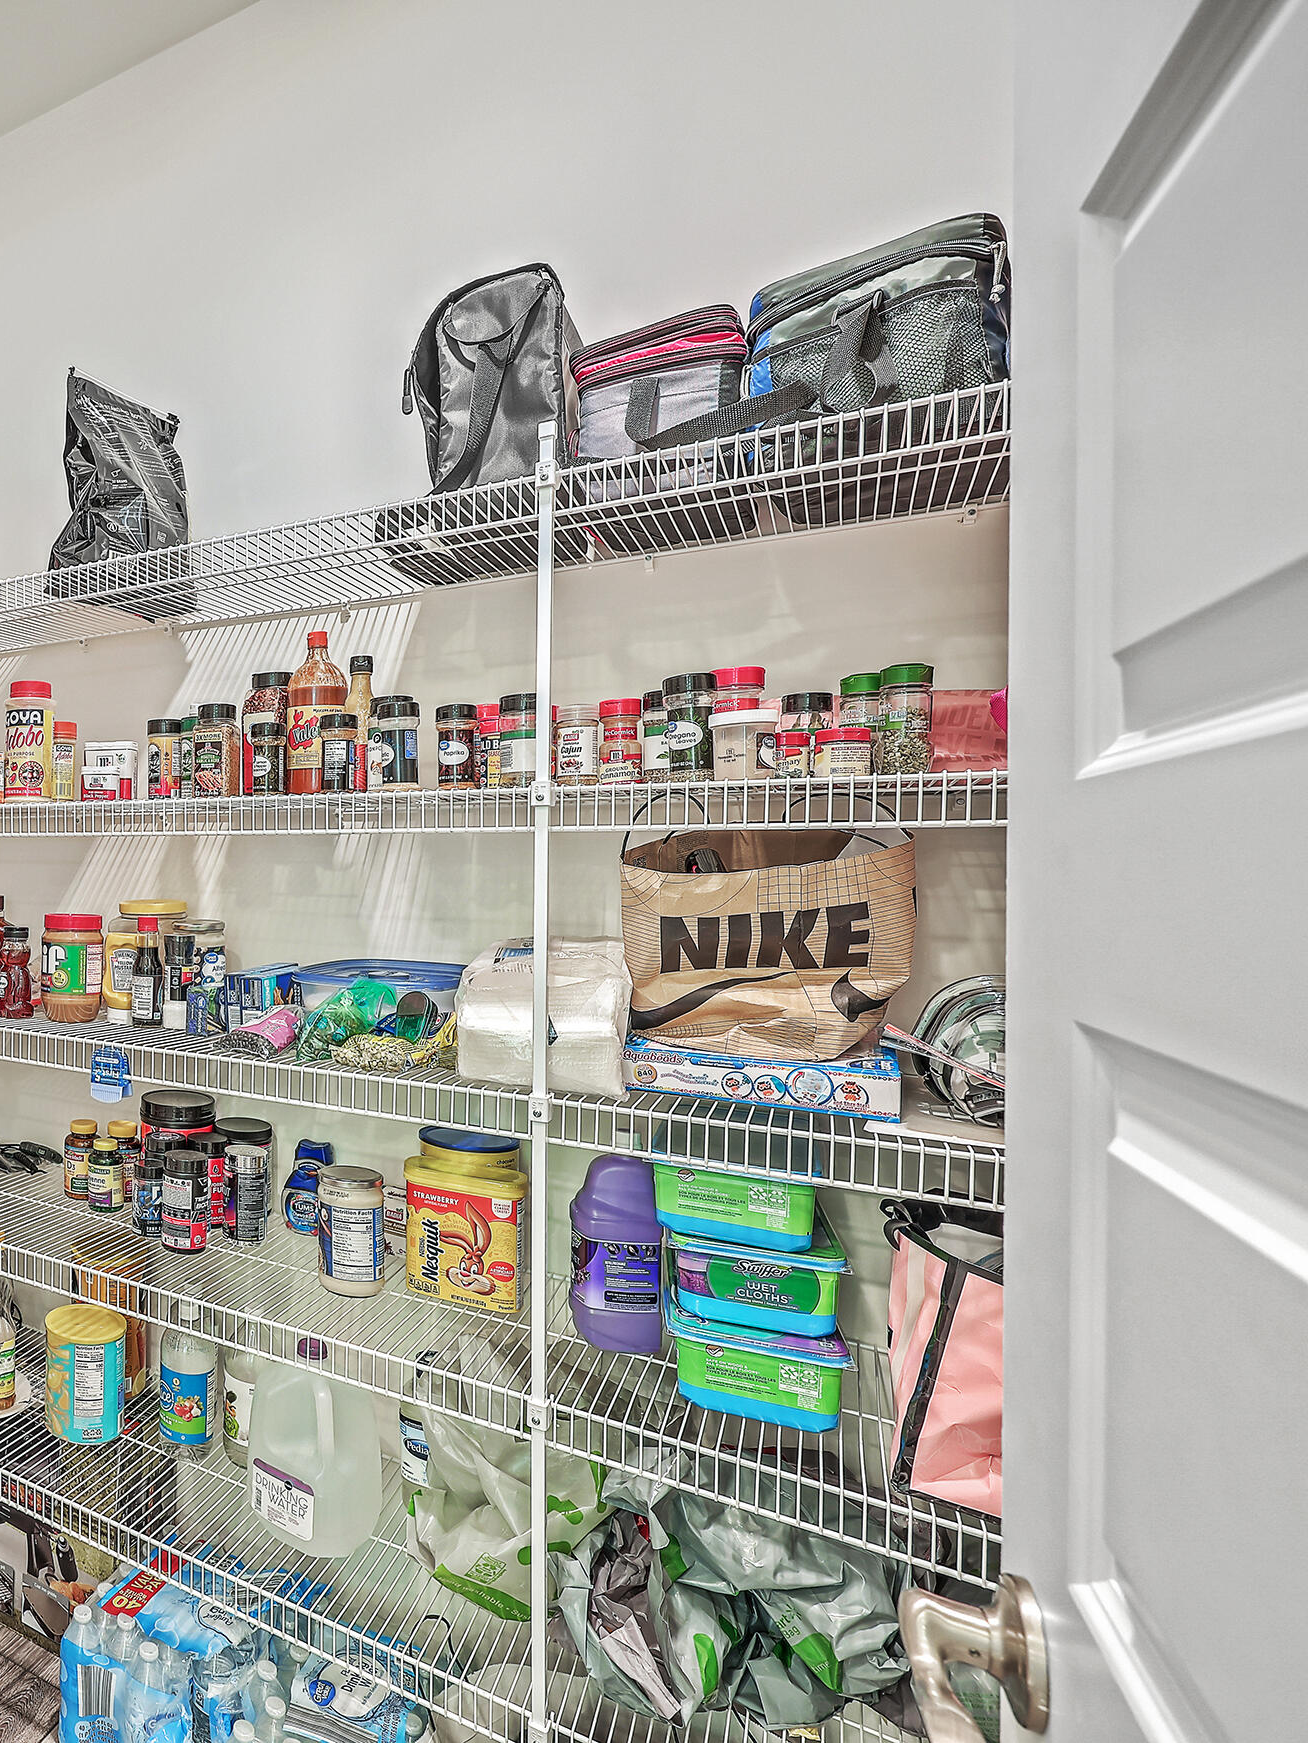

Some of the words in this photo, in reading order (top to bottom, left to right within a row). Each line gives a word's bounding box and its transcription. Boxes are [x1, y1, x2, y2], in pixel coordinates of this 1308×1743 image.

[604, 729, 635, 737] McCormick
[443, 750, 465, 758] Paprika
[560, 745, 582, 755] Cajun
[605, 765, 629, 773] GROUND
[659, 901, 871, 974] NIKE
[42, 944, 67, 975] if
[114, 950, 136, 959] HEINZ
[623, 1050, 684, 1065] Aquabeads
[637, 1069, 653, 1077] 840
[66, 1160, 76, 1171] D3
[413, 1191, 459, 1206] STRAWBERRY
[295, 1203, 315, 1213] TUMS
[421, 1217, 446, 1283] Nesquik
[733, 1259, 793, 1279] Swiffer
[746, 1281, 778, 1292] WET
[736, 1288, 789, 1305] CLOTHS
[406, 1441, 430, 1455] Pedia
[255, 1472, 309, 1510] DRINKING
[267, 1490, 307, 1519] WATER
